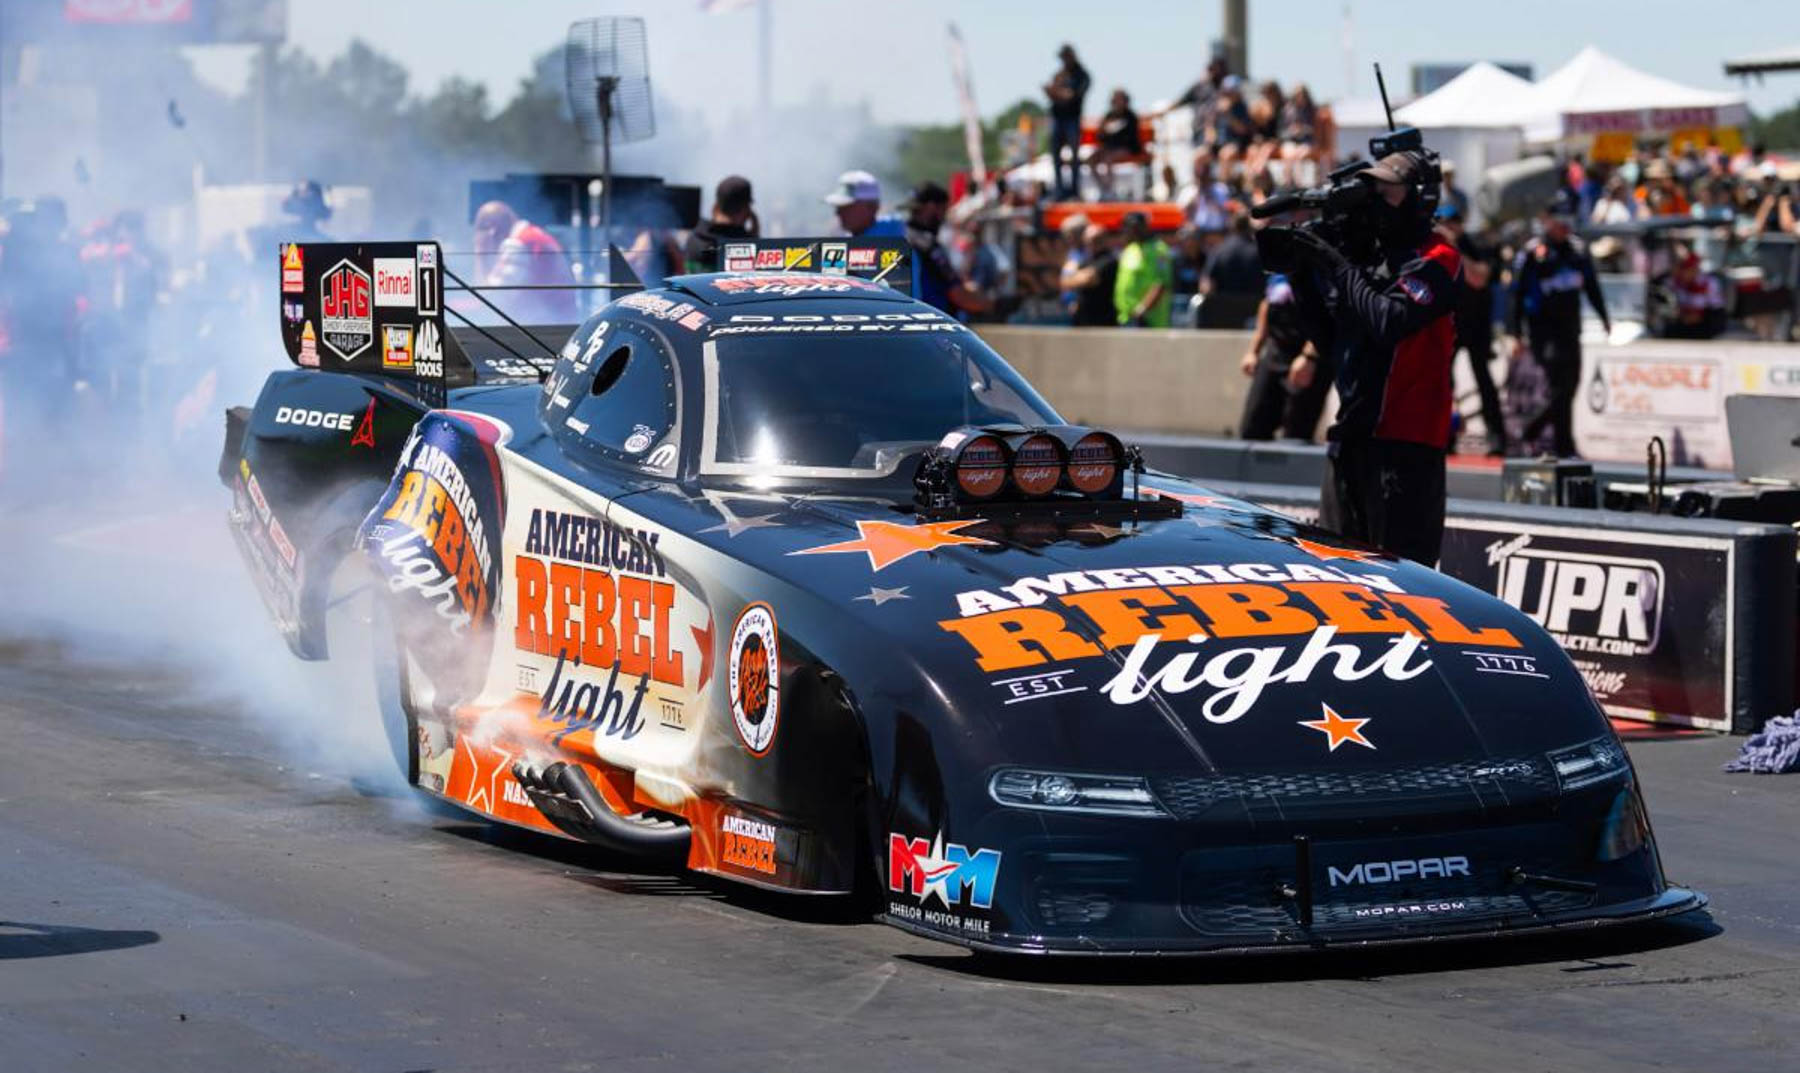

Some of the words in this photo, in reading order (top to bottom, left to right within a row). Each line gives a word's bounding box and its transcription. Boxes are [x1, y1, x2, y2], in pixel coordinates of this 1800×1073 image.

[323, 268, 371, 318] JHG
[378, 269, 412, 295] Rinnai
[423, 270, 431, 308] 1
[730, 312, 944, 322] DODGE
[415, 319, 443, 361] MAC
[415, 362, 443, 377] TOOLS
[275, 406, 355, 431] DODGE
[414, 445, 492, 585] AMERICAN
[525, 508, 665, 577] AMERICAN
[955, 563, 1407, 617] AMERICAN
[1503, 556, 1658, 641] UPR
[515, 555, 684, 688] REBEL
[937, 581, 1523, 672] REBEL
[1099, 625, 1433, 724] light
[1475, 656, 1536, 672] 1776
[537, 647, 650, 747] light
[1008, 673, 1066, 698] EST
[661, 704, 683, 725] 1776
[503, 780, 535, 808] NAS
[722, 814, 776, 844] AMERICAN
[722, 831, 777, 875] REBEL
[1328, 855, 1472, 887] MOPAR
[890, 902, 922, 920] SHELOR
[925, 910, 960, 929] MOTOR
[963, 918, 991, 933] MILE
[1356, 901, 1466, 917] MOPAR.COM
